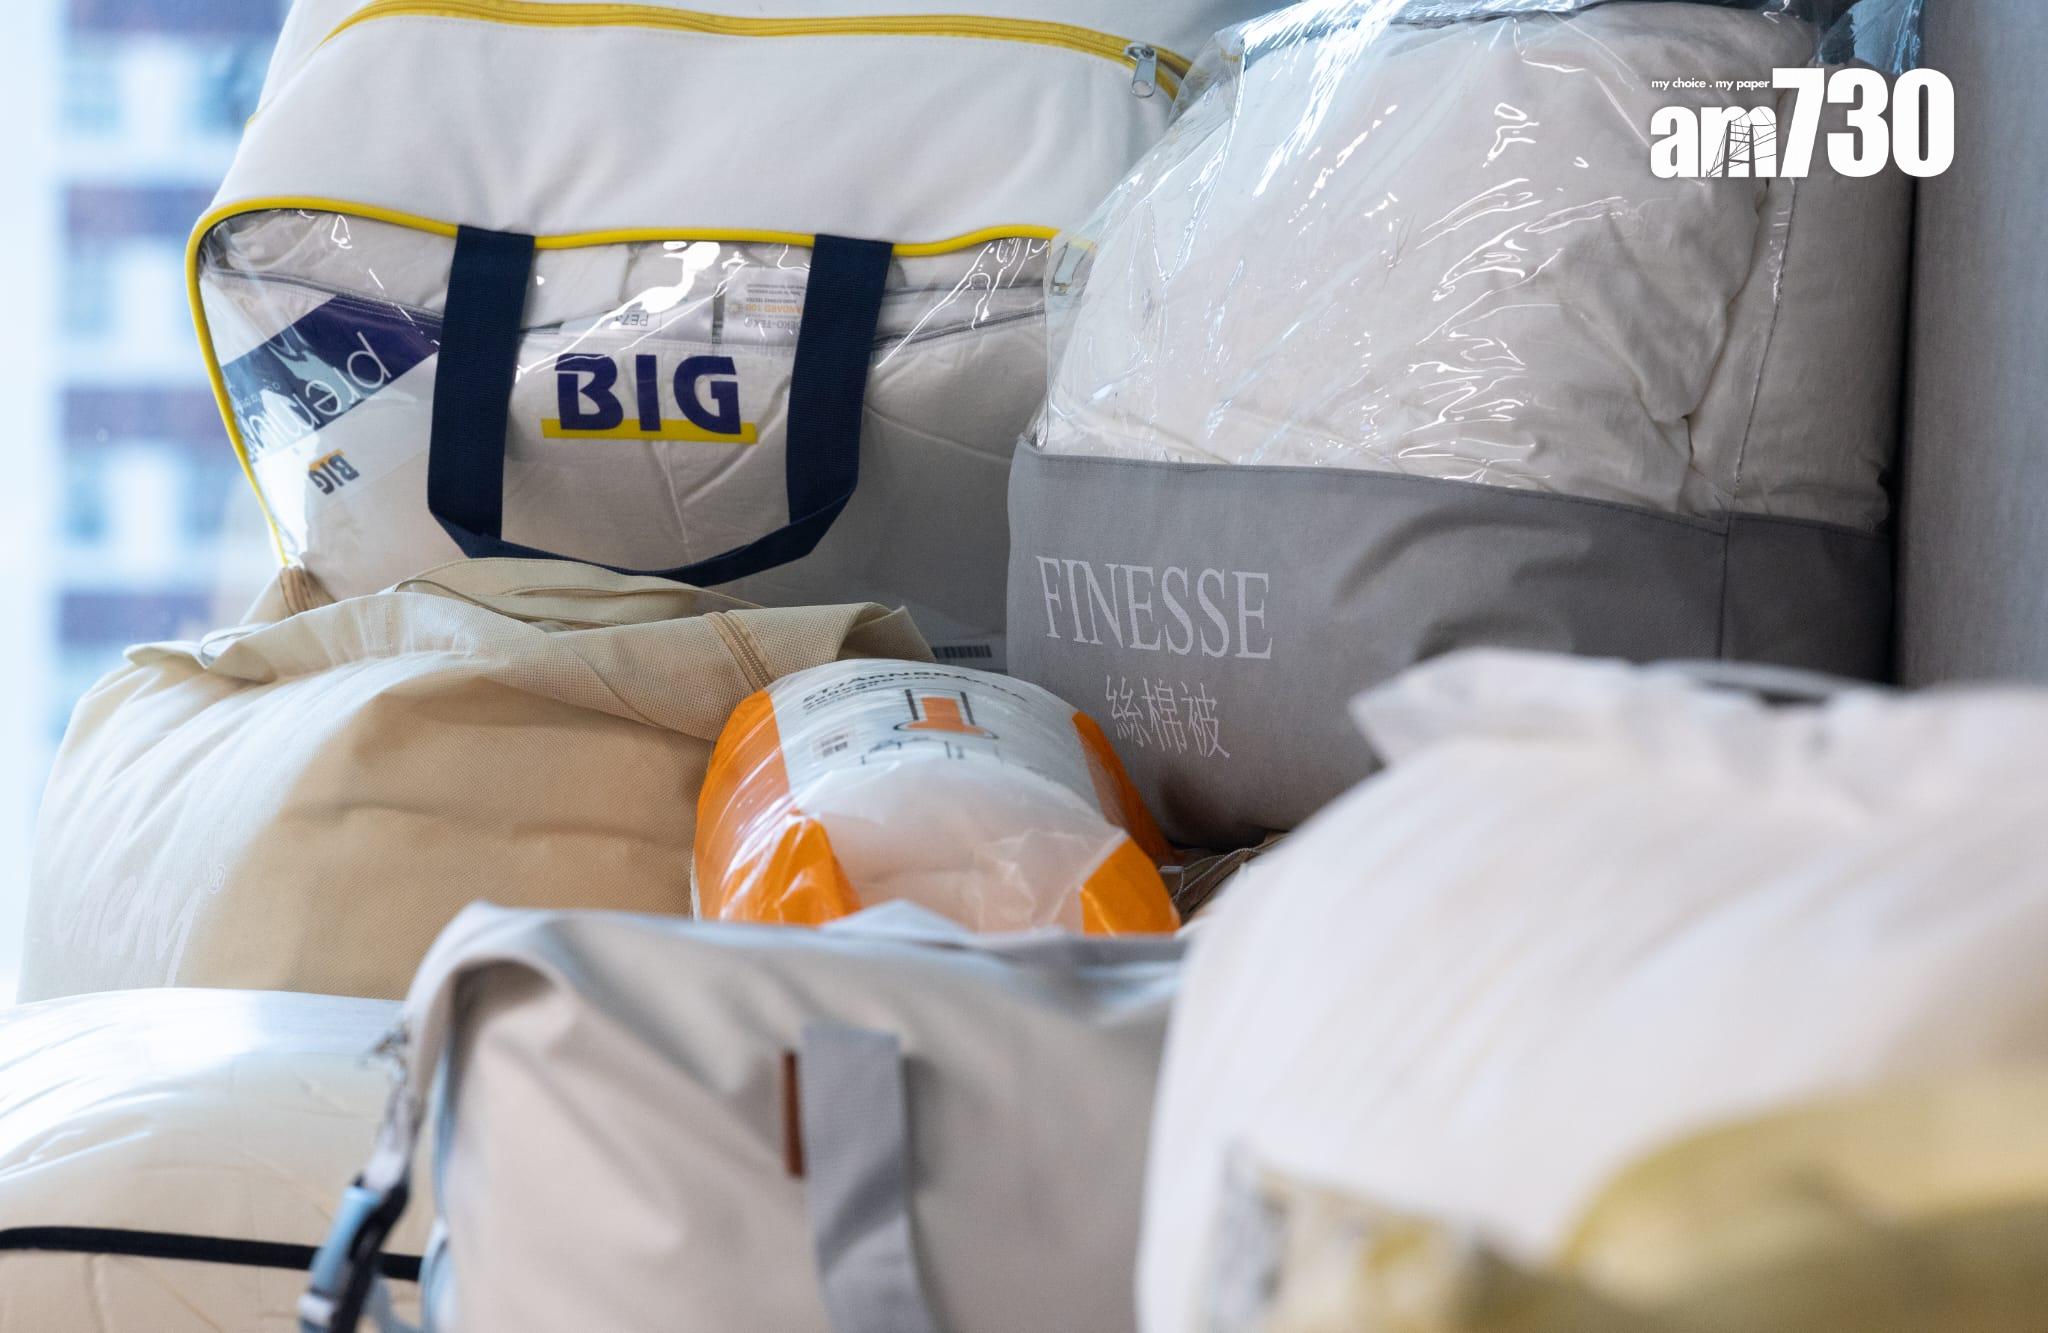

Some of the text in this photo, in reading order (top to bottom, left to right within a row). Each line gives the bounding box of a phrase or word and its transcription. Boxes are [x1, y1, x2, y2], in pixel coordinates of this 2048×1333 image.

[555, 353, 742, 435] BIG
[308, 454, 360, 495] BIG
[1036, 556, 1273, 660] FINESSE
[1106, 675, 1231, 758] 絲棉被
